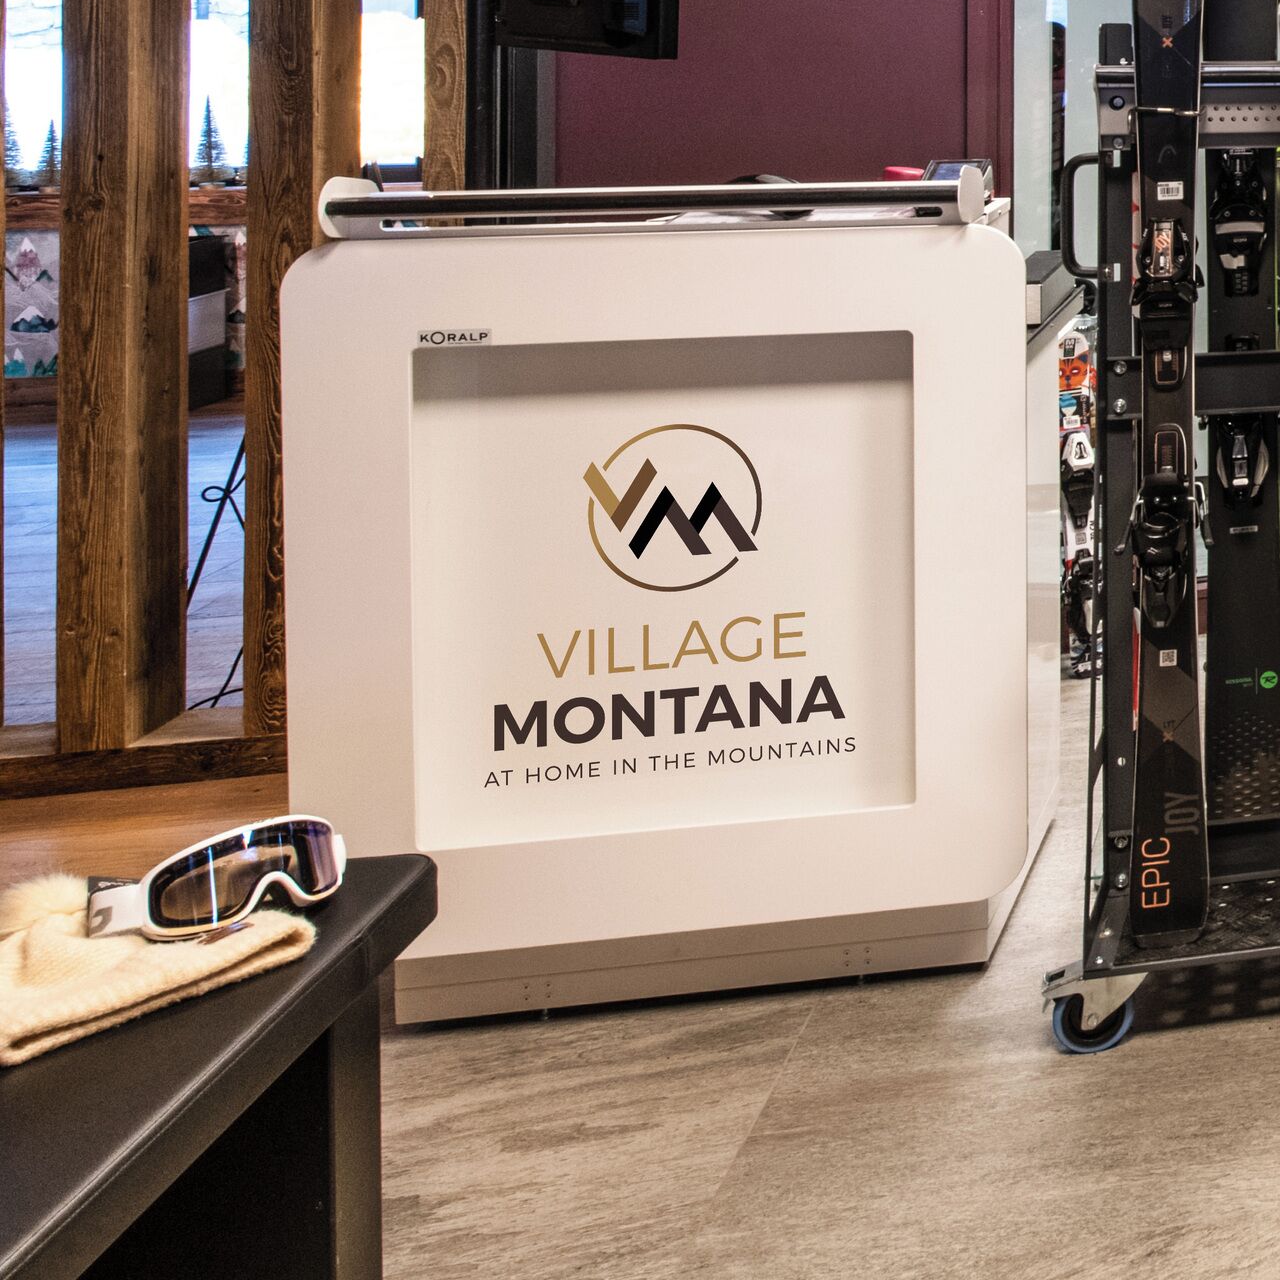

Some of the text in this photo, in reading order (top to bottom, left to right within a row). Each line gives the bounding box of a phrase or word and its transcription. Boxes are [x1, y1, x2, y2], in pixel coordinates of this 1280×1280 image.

[419, 331, 489, 344] KORALP
[537, 612, 808, 680] VILLAGE
[492, 675, 846, 752] MONTANA
[483, 737, 858, 788] AT HOME IN THE MOUNTAINS
[1163, 790, 1201, 837] JOY
[1141, 836, 1171, 910] EPIC
